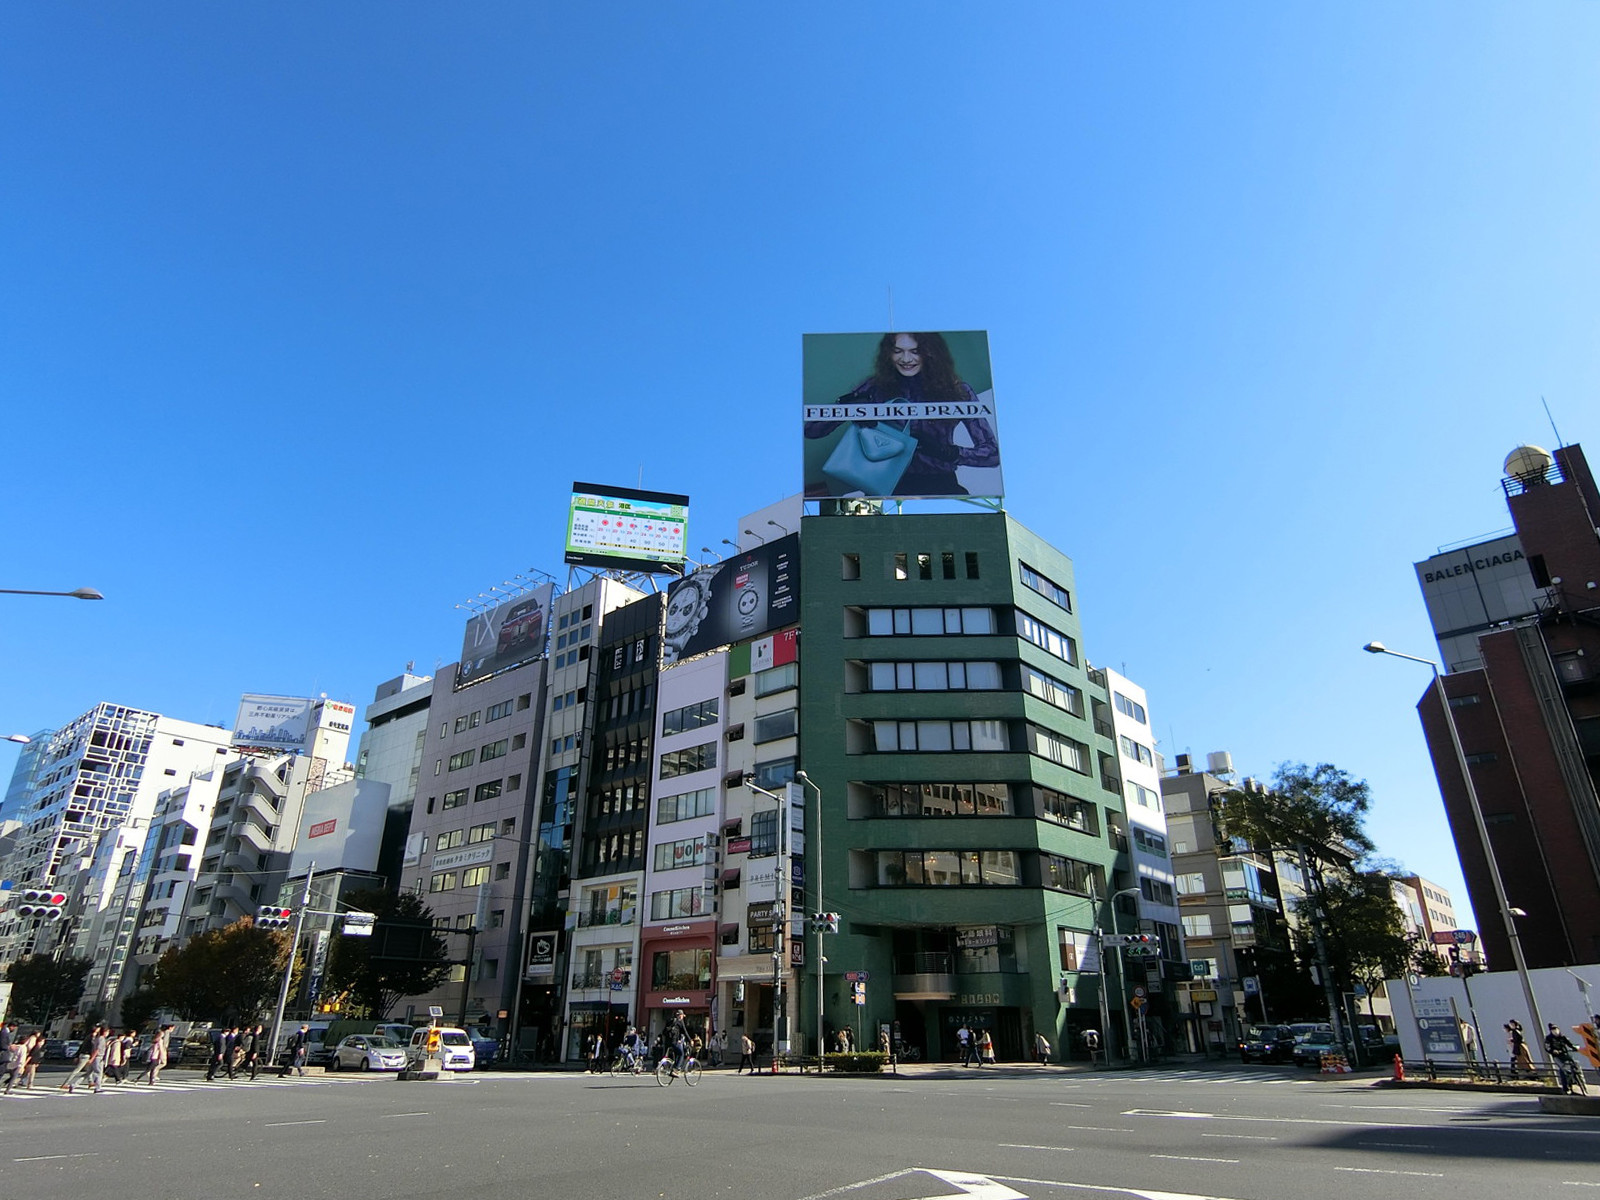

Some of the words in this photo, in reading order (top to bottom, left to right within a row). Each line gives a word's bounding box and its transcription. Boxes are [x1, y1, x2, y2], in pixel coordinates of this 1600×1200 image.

[806, 407, 867, 418] FEELS
[873, 406, 919, 417] LIKE
[925, 404, 992, 415] PRADA
[1425, 550, 1525, 583] BALENCIAGA
[784, 631, 795, 641] 7F
[750, 910, 768, 918] PARTY
